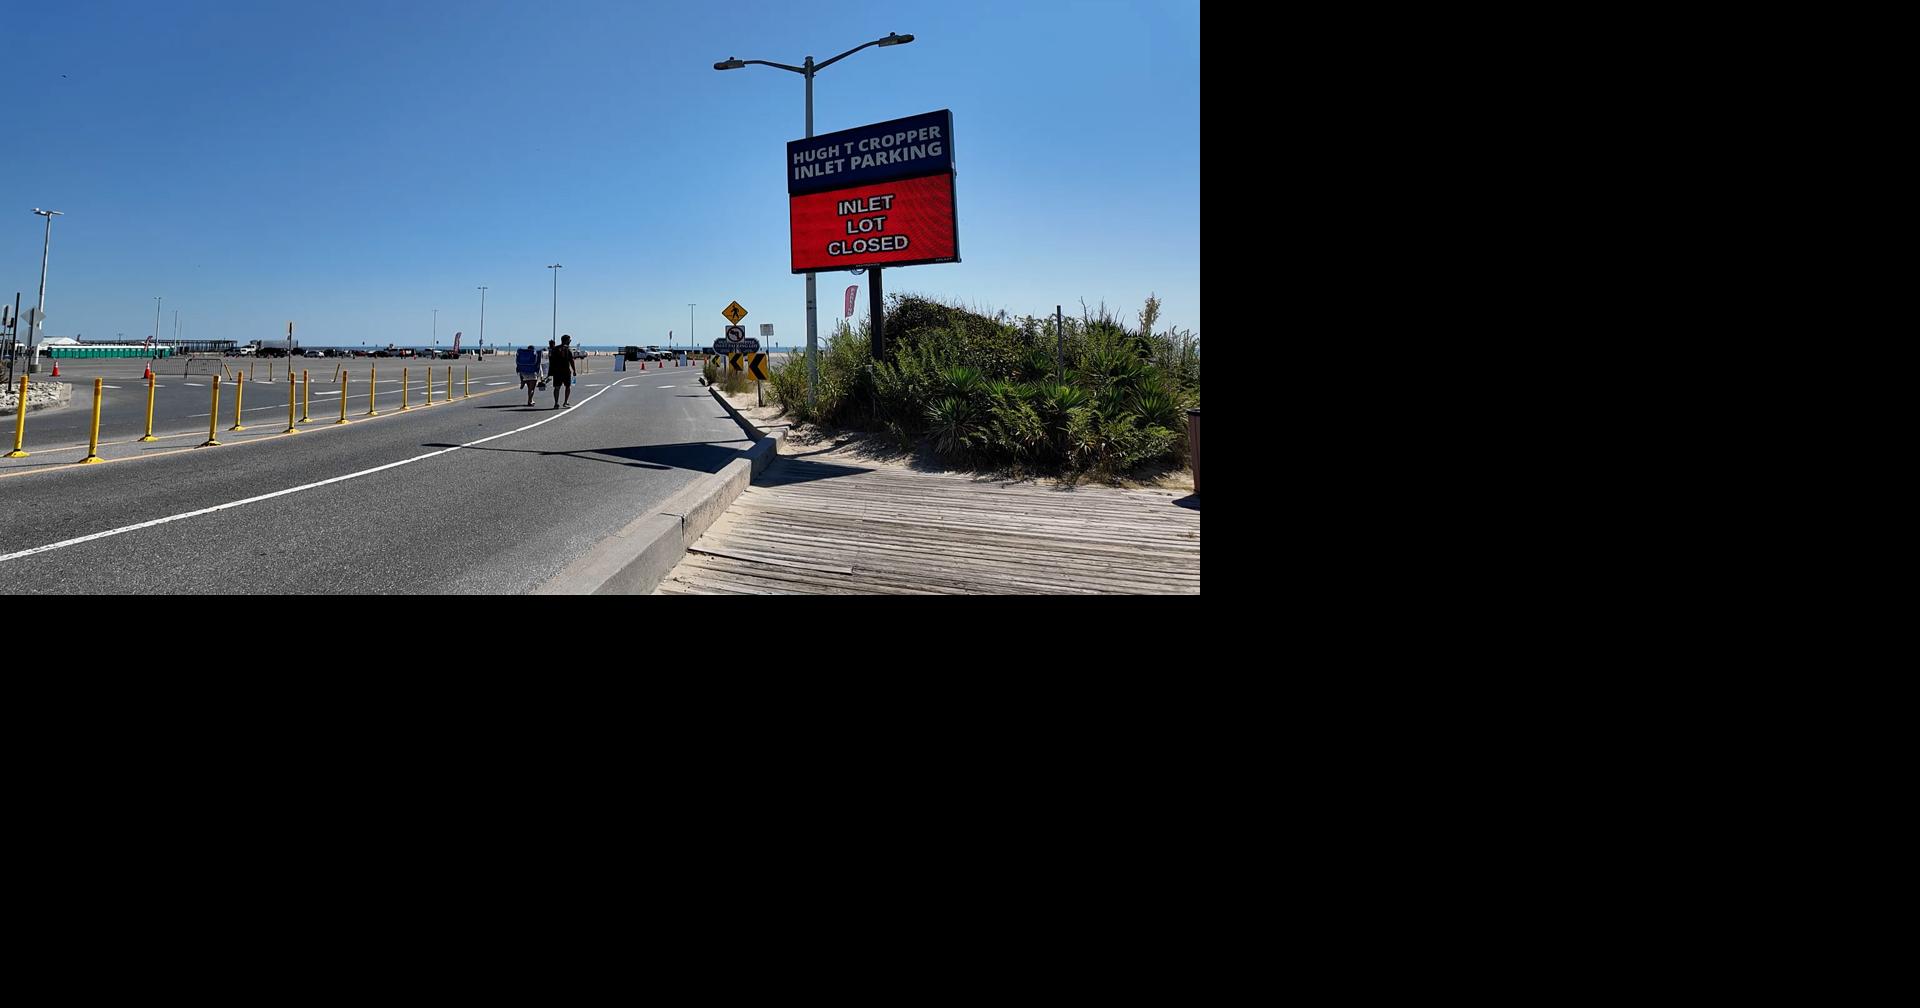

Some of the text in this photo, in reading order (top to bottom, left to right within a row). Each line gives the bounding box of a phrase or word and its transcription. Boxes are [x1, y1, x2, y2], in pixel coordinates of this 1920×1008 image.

[793, 126, 942, 165] HUGH T CROPPER
[794, 141, 942, 180] INLET PARKING
[838, 195, 894, 215] INLET
[847, 217, 886, 234] LOT
[828, 236, 908, 256] CLOSED
